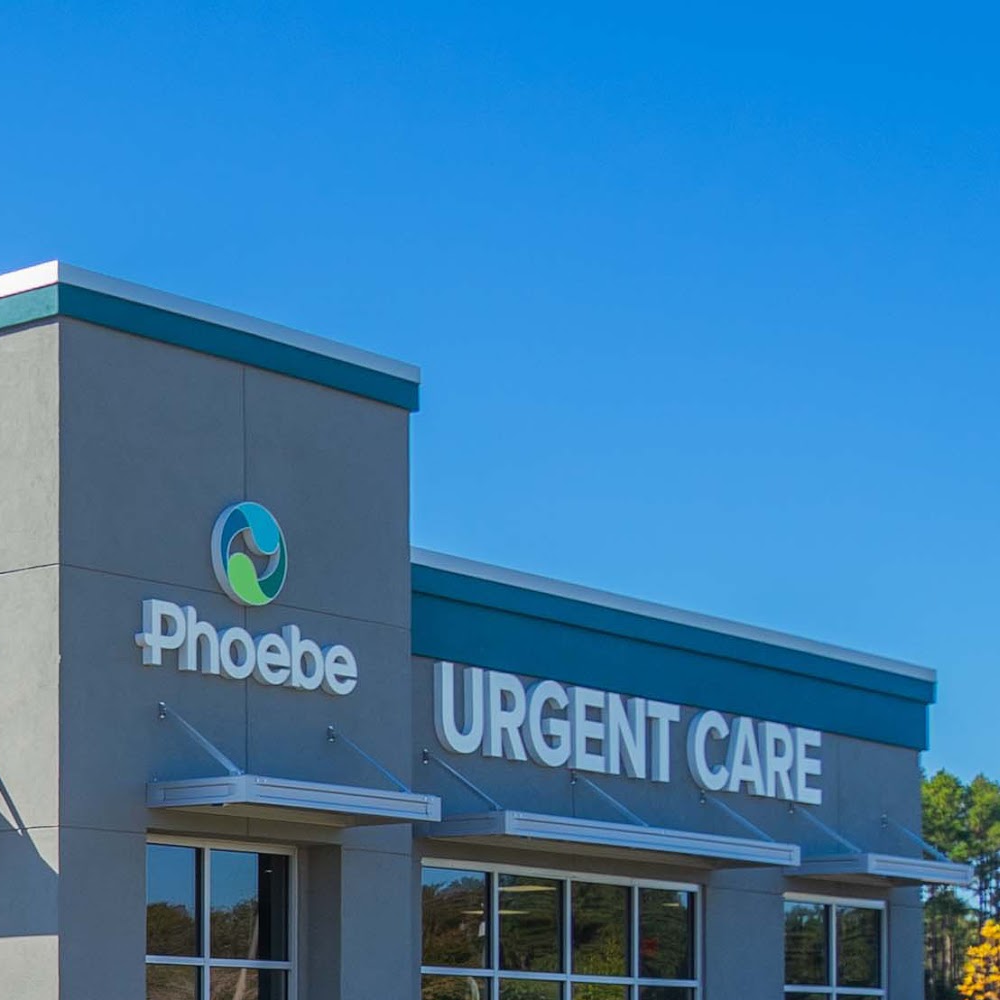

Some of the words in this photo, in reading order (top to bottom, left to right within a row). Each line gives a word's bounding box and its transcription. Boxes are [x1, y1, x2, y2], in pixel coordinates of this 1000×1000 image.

[135, 598, 358, 696] Phoebe
[433, 661, 680, 783] URGENT
[686, 710, 822, 805] CARE
